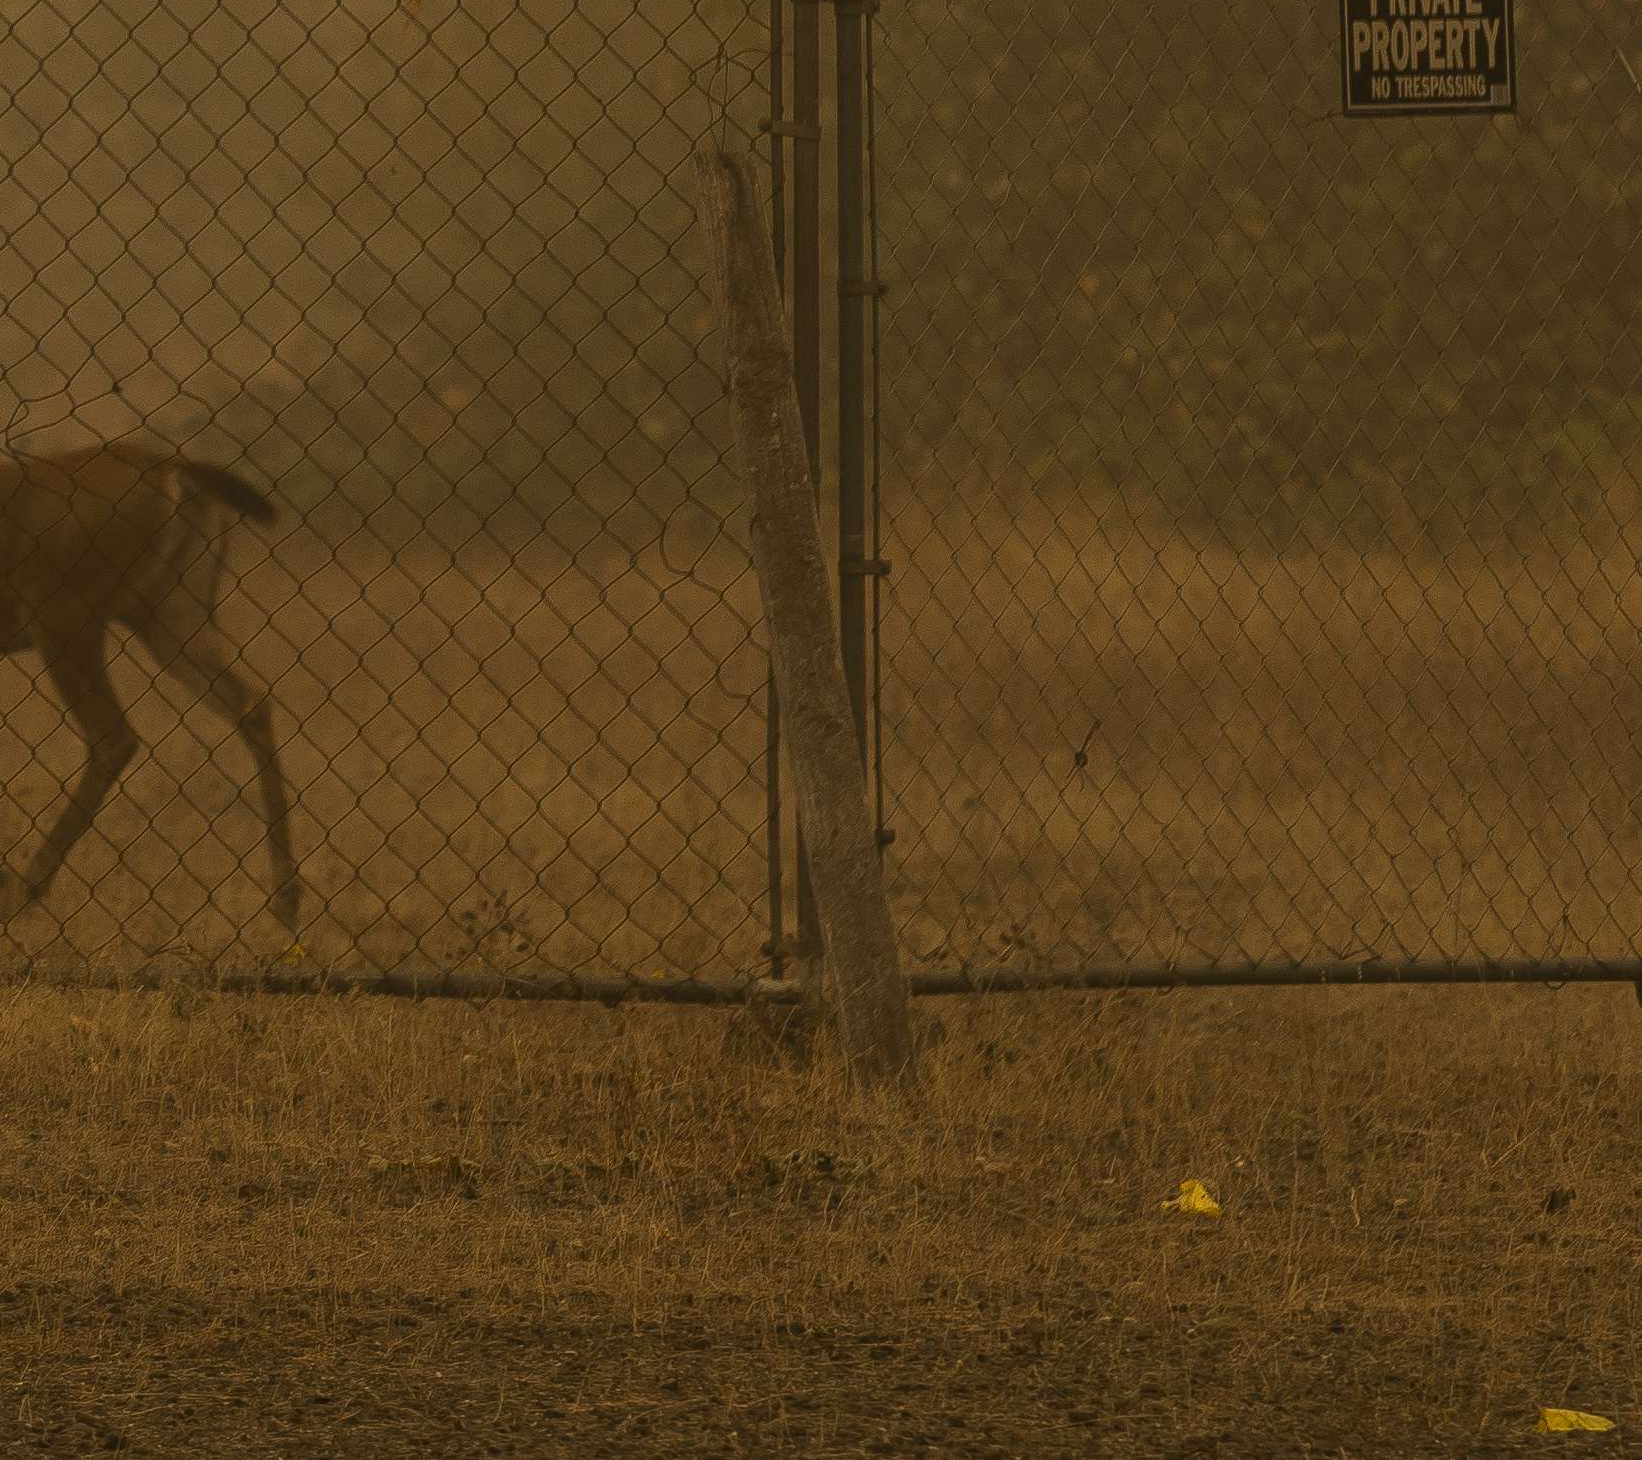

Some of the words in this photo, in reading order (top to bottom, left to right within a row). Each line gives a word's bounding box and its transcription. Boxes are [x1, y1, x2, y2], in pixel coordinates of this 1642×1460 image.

[1353, 18, 1499, 72] PROPERTY
[1371, 77, 1390, 98] NO
[1395, 75, 1486, 98] TRESPASSING
